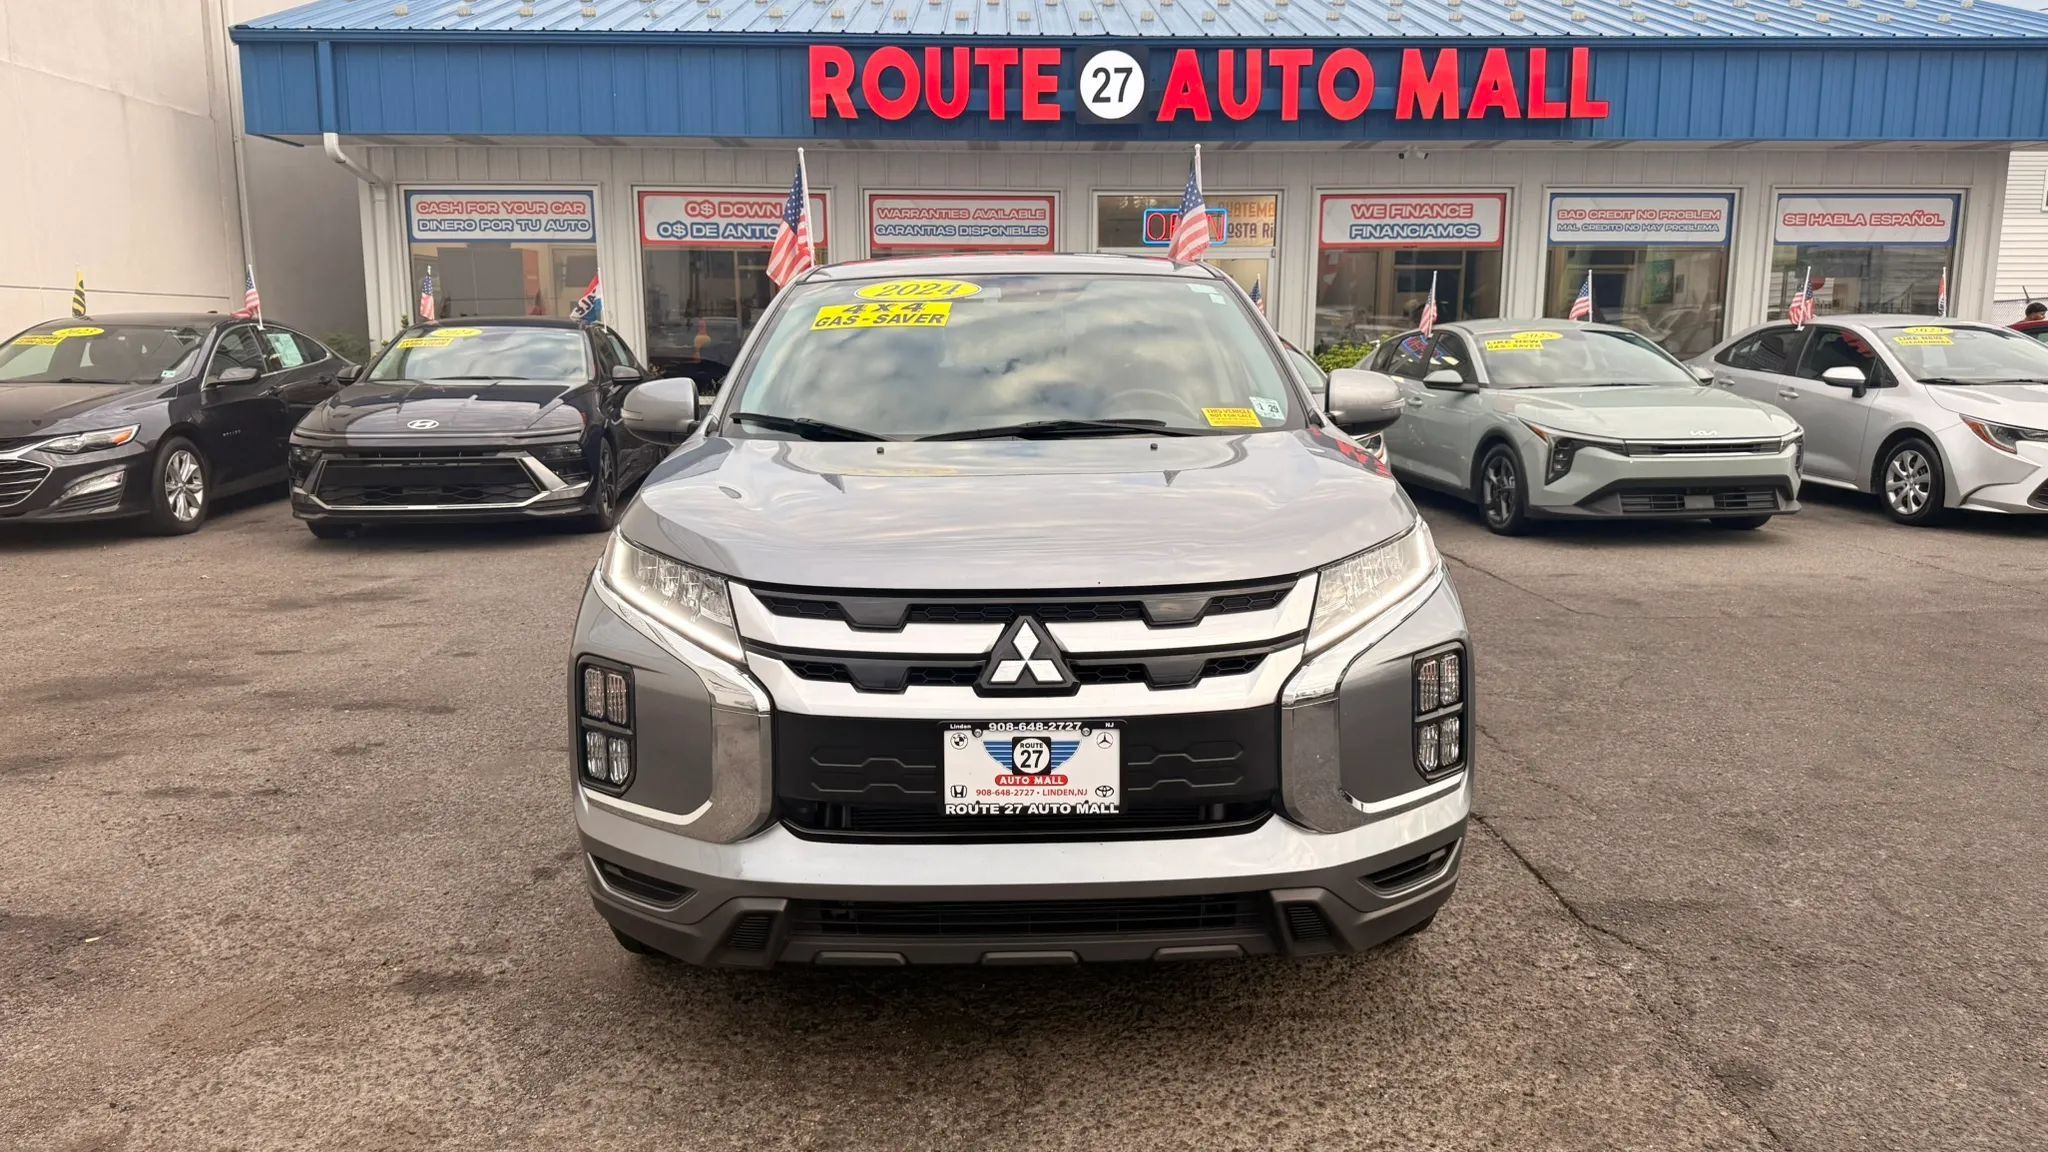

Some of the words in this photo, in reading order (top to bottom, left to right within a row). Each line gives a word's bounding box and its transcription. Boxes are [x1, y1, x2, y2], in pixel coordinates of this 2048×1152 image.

[808, 45, 1062, 121] ROUTE
[1091, 68, 1133, 104] 27
[1156, 47, 1374, 122] AUTO
[1395, 46, 1609, 121] MALL
[416, 201, 463, 215] CASH
[466, 201, 499, 215] FOR
[502, 201, 548, 215] YOUR
[551, 201, 586, 214] CAR
[718, 202, 783, 218] DOWN
[877, 208, 970, 220] WARRANTIES
[973, 208, 1046, 220] AVAILABLE
[1351, 204, 1386, 219] WE
[1389, 203, 1473, 219] FINANCE
[1557, 210, 1586, 220] BAD
[1588, 210, 1635, 220] CREDIT
[1636, 210, 1657, 220] NO
[1659, 210, 1722, 220] PROBLEM
[1784, 213, 1808, 225] SE
[1809, 213, 1867, 225] HABLA
[1869, 210, 1945, 225] ESPAÑOL
[418, 219, 476, 231] DINERO
[479, 219, 514, 231] POR
[516, 219, 541, 231] TU
[544, 219, 591, 231] AUTO
[690, 223, 719, 239] DE
[875, 224, 955, 236] GARANTIAS
[958, 224, 1048, 236] DISPONIBLES
[1350, 224, 1480, 239] FINANCIAMOS
[1557, 223, 1580, 232] MAL
[1581, 223, 1623, 232] CREDITO
[1624, 223, 1641, 232] NO
[1642, 223, 1663, 232] HAY
[1664, 223, 1720, 232] PROBLEMA
[874, 283, 962, 297] 2024
[988, 722, 1082, 732] 908-648-2727
[1020, 750, 1044, 769] 27
[1000, 776, 1029, 785] AUTO
[1034, 776, 1064, 785] MALL
[976, 789, 1035, 797] 908-648-2727
[945, 804, 999, 815] ROUTE
[1004, 803, 1023, 815] 27
[1027, 803, 1072, 815] AUTO
[1076, 803, 1119, 814] MALL
